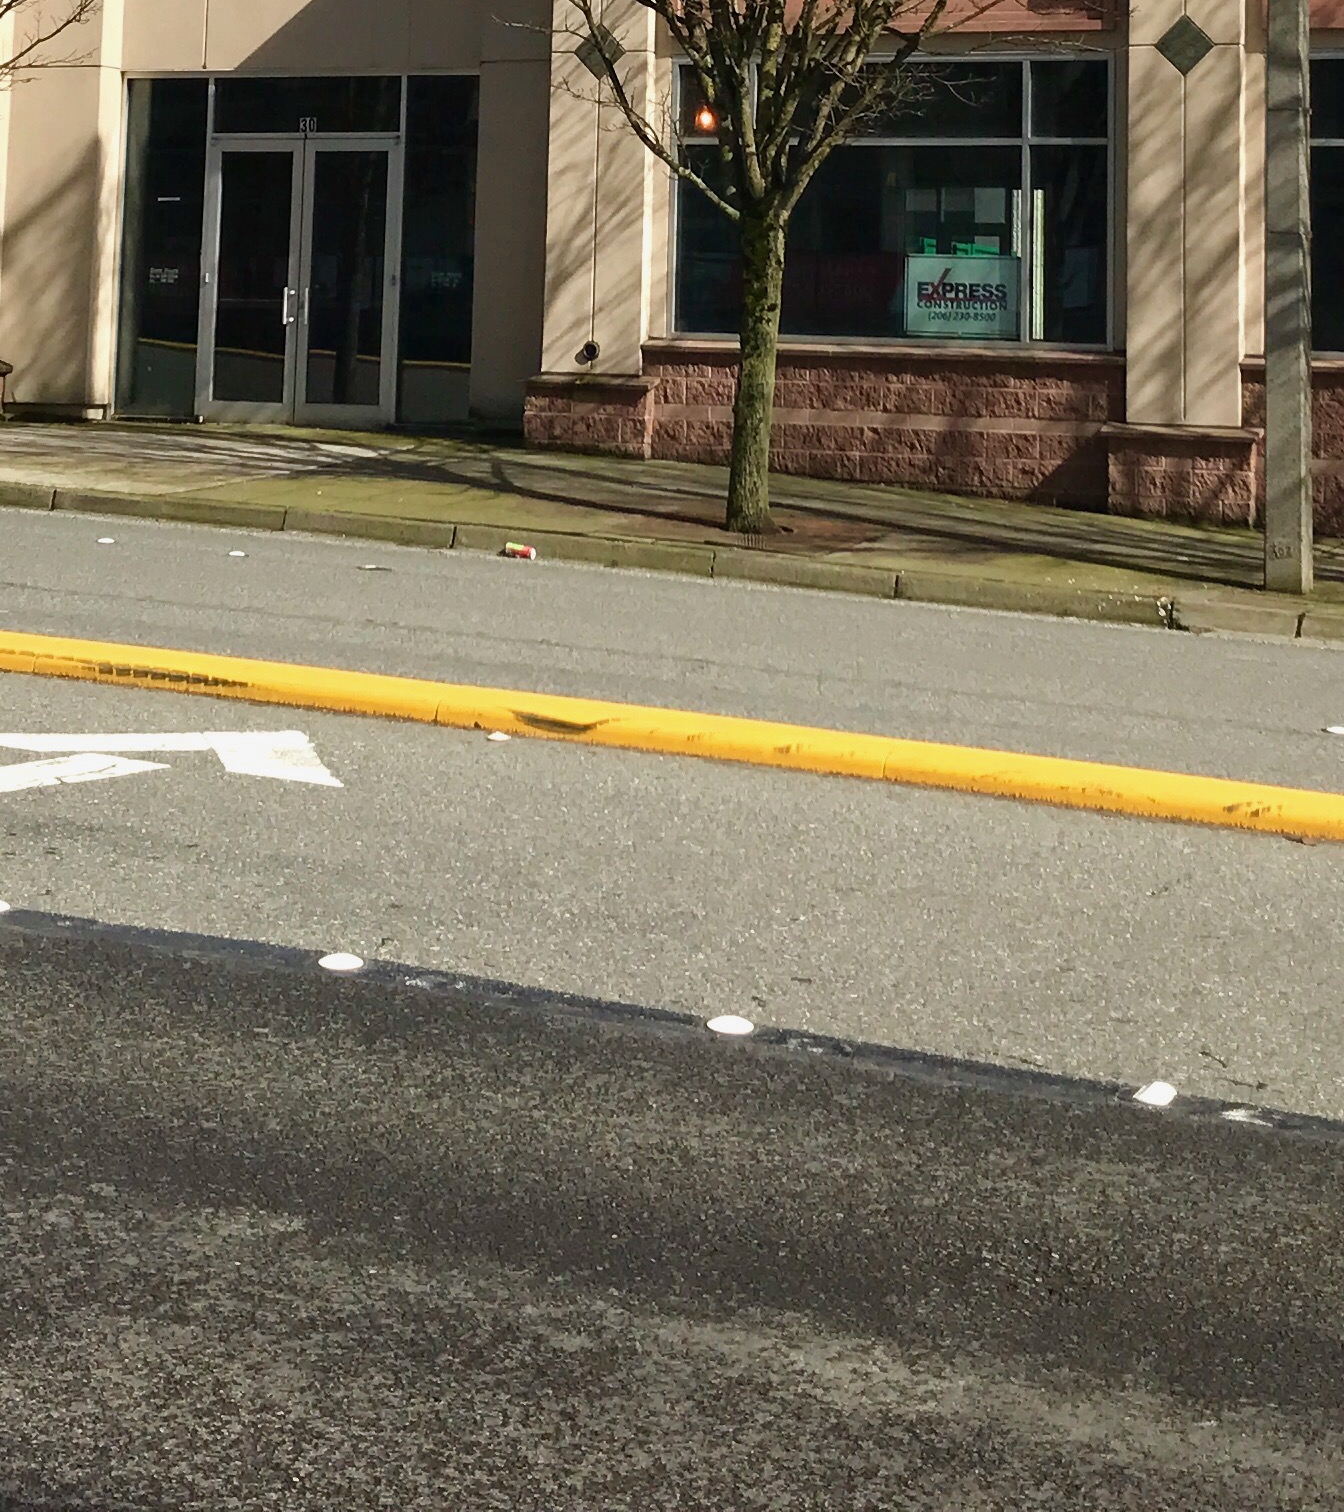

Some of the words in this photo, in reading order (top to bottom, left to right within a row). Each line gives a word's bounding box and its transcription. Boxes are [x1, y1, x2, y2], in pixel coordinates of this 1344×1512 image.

[300, 118, 315, 133] 30
[917, 281, 1007, 300] EXPRESS
[917, 300, 1008, 310] CONSTRUCTION
